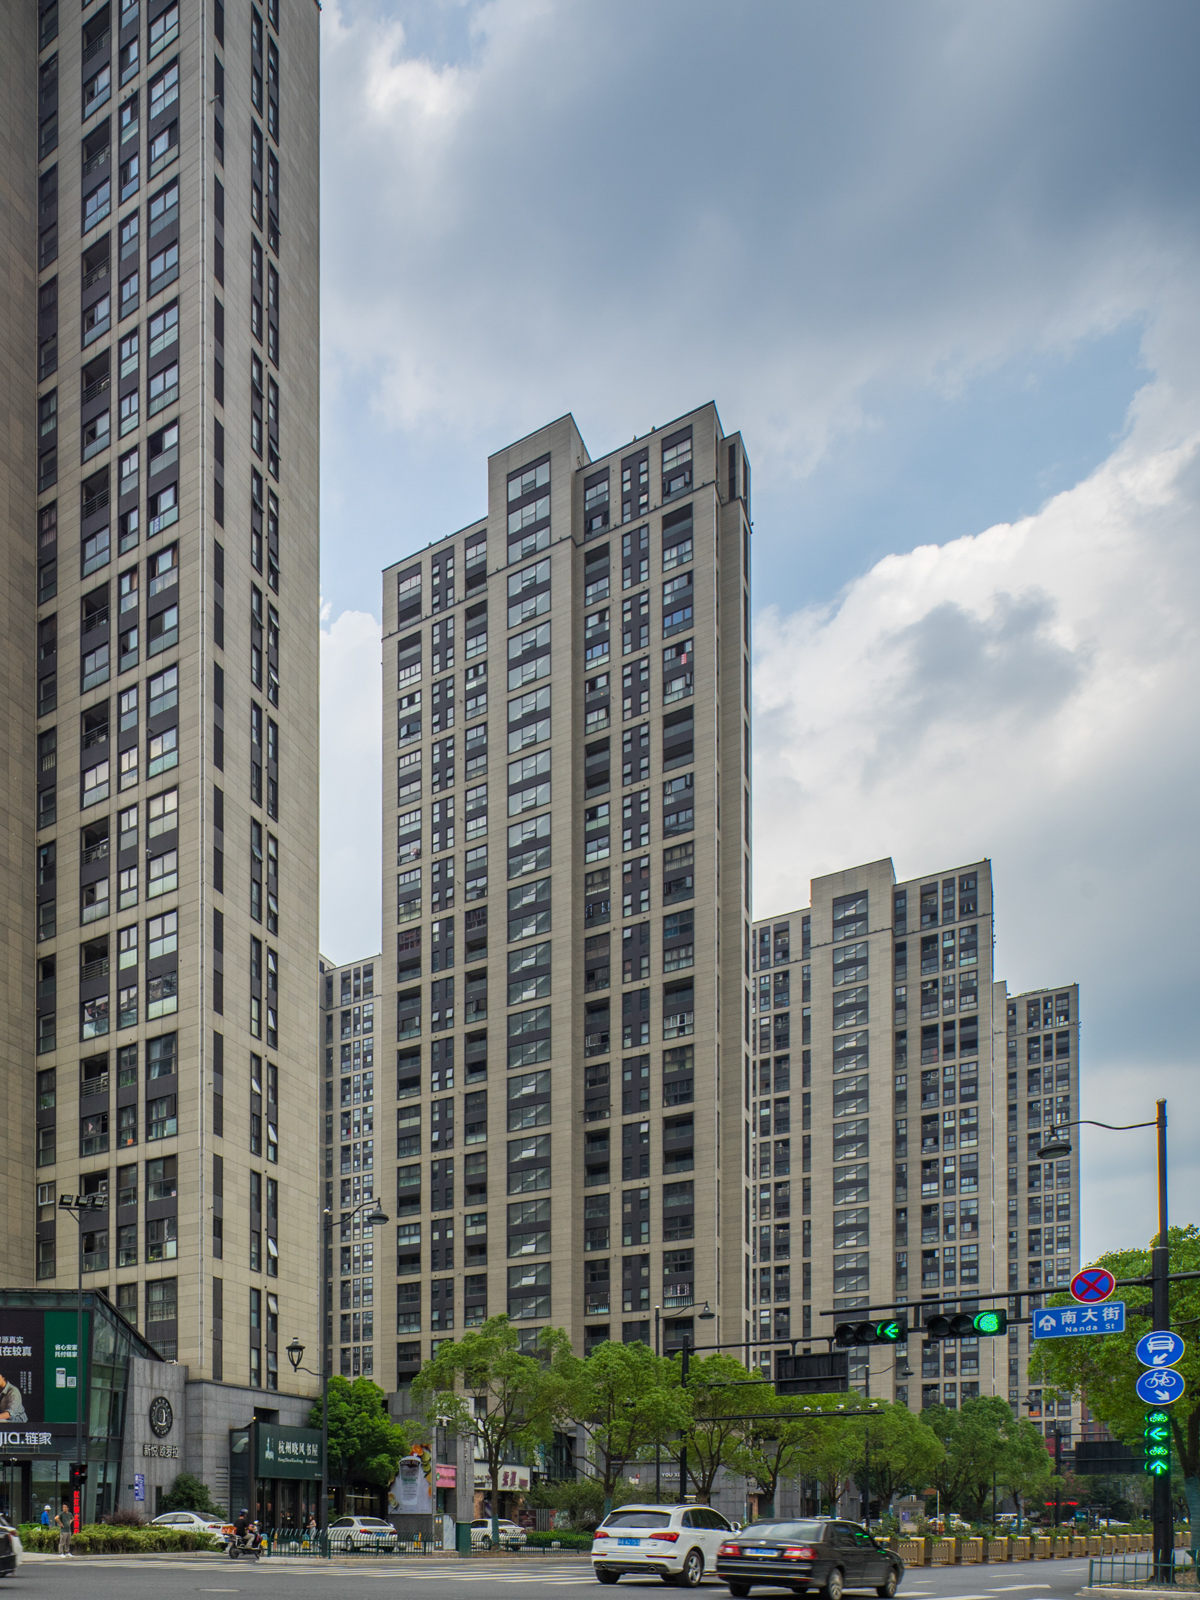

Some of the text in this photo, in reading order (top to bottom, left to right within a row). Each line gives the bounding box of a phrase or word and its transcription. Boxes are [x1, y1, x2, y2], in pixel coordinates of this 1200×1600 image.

[1060, 1306, 1120, 1326] 南大街
[1065, 1324, 1098, 1333] Nanda
[278, 1440, 319, 1457] 杭州晓风书屋
